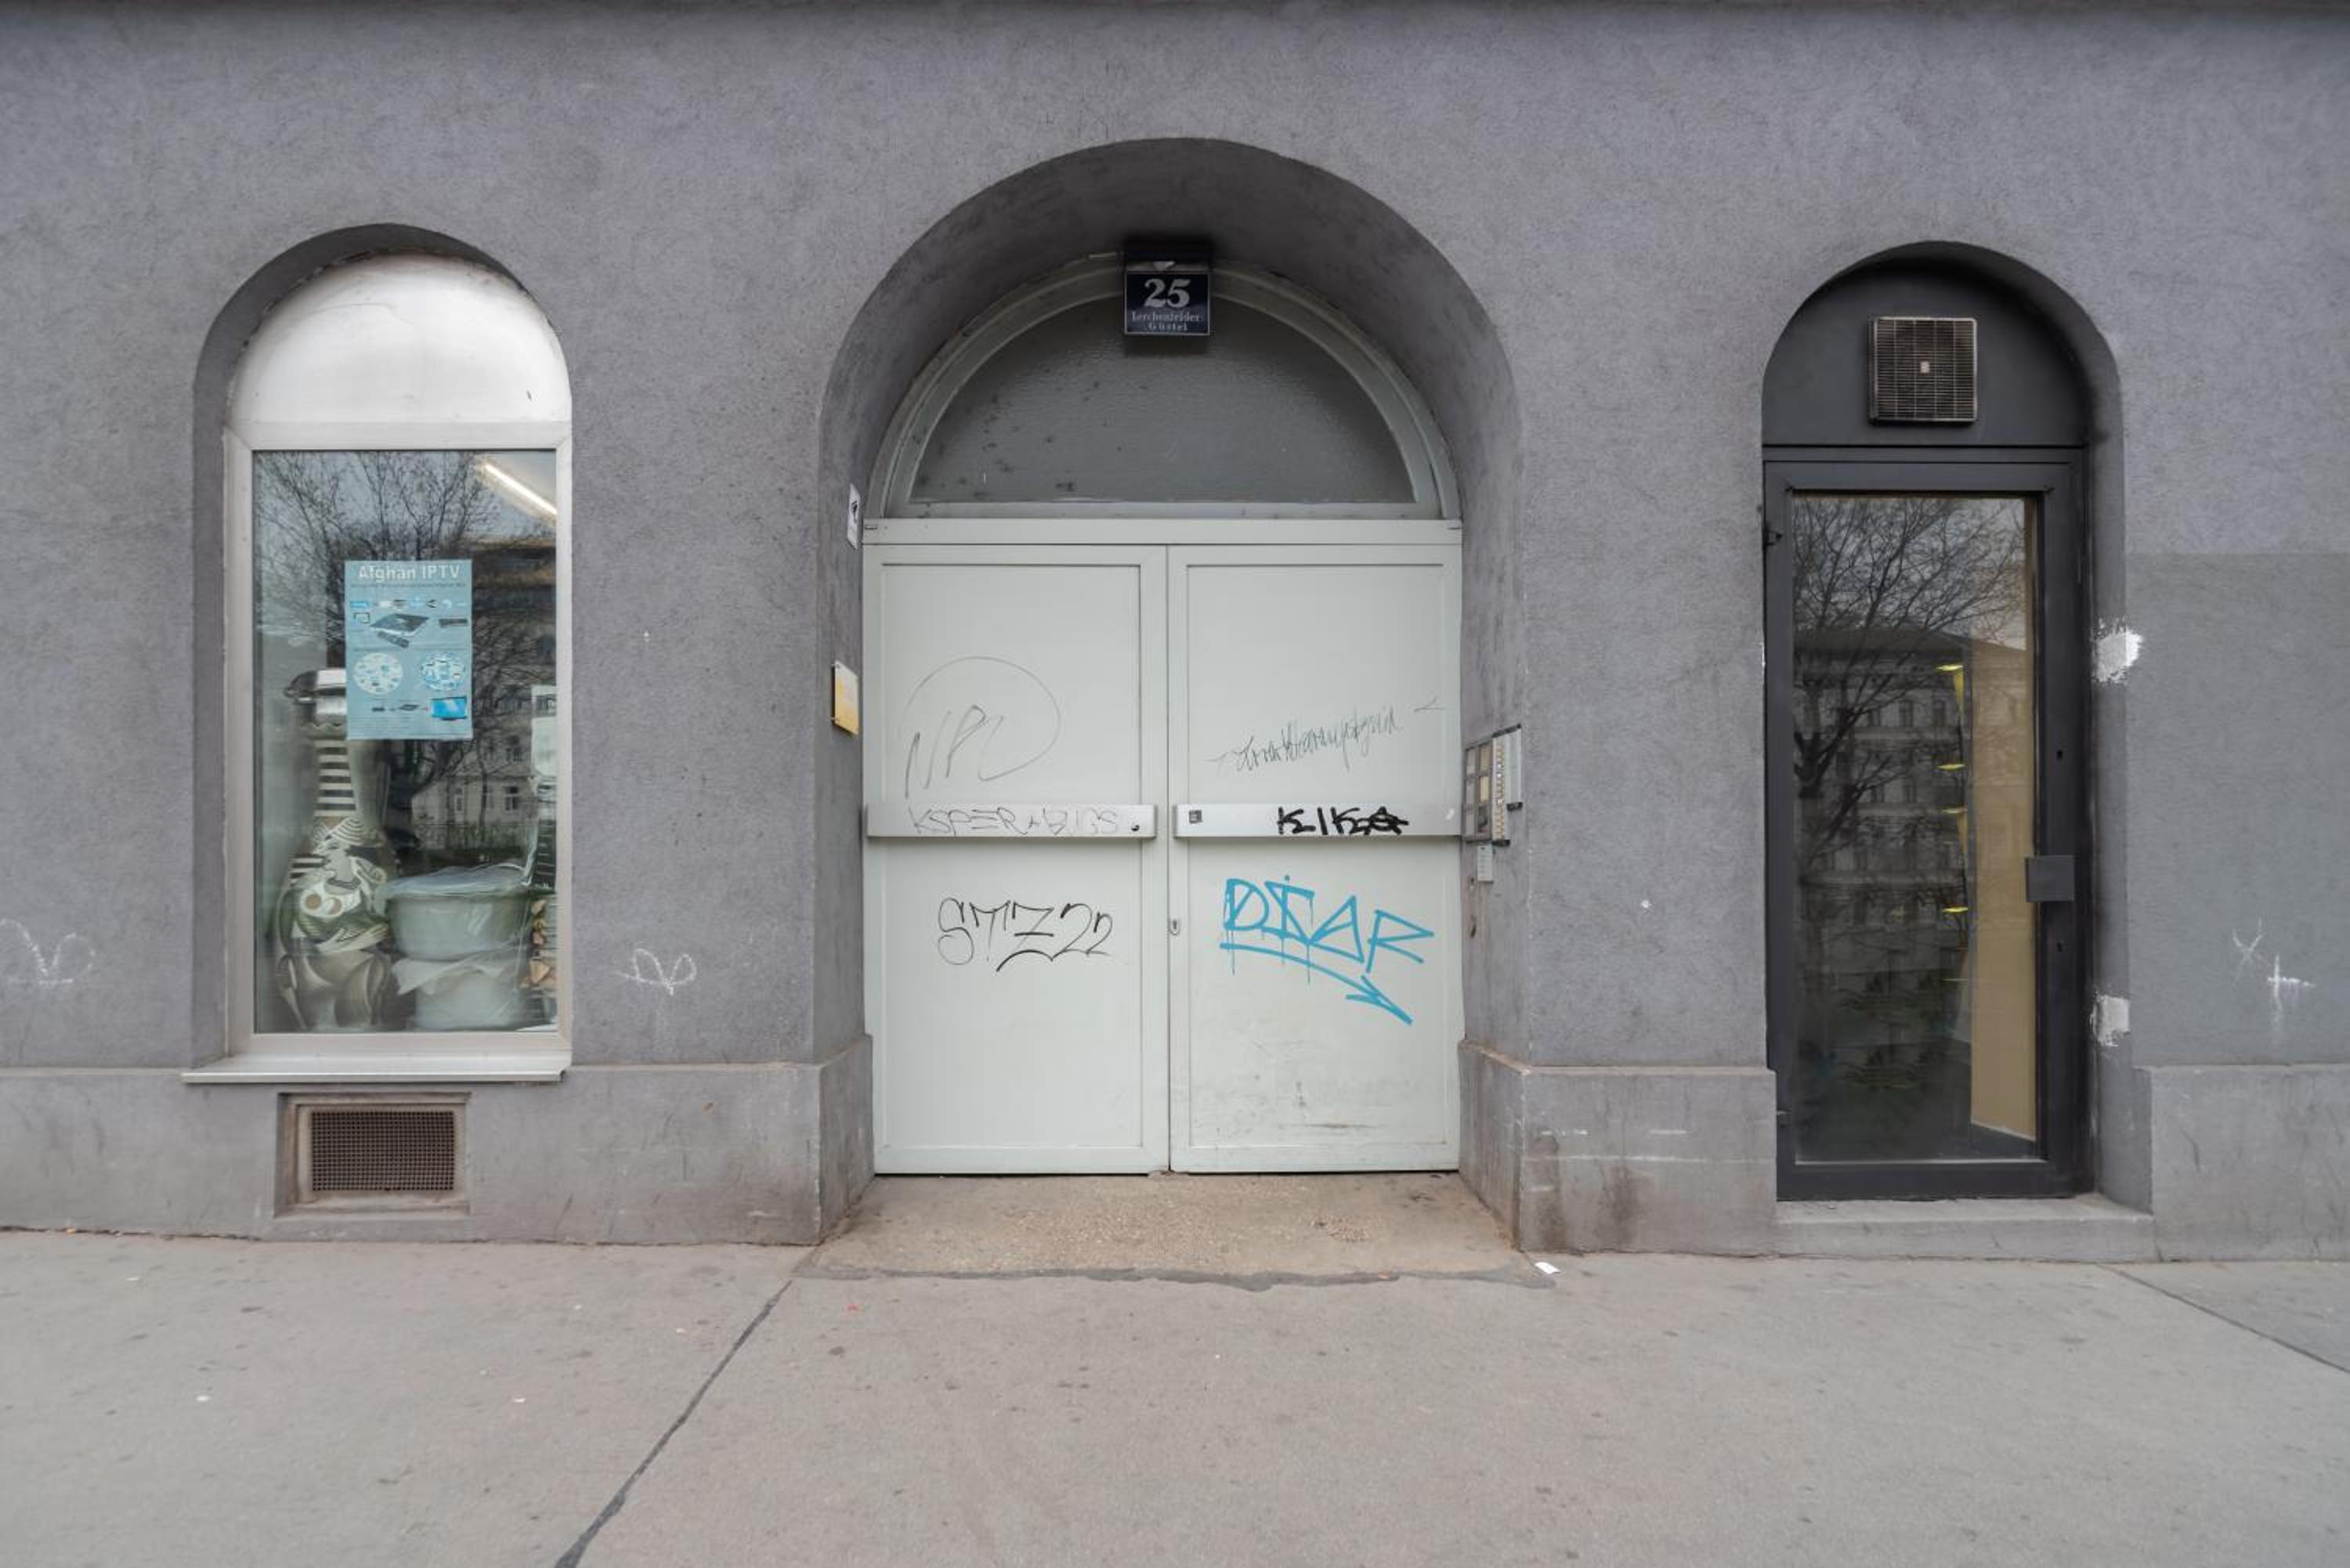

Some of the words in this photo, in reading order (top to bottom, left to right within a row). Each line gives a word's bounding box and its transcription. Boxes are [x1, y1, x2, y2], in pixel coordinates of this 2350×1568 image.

[1144, 278, 1191, 308] 25
[359, 565, 415, 583] Afghan
[421, 564, 461, 579] IPTV
